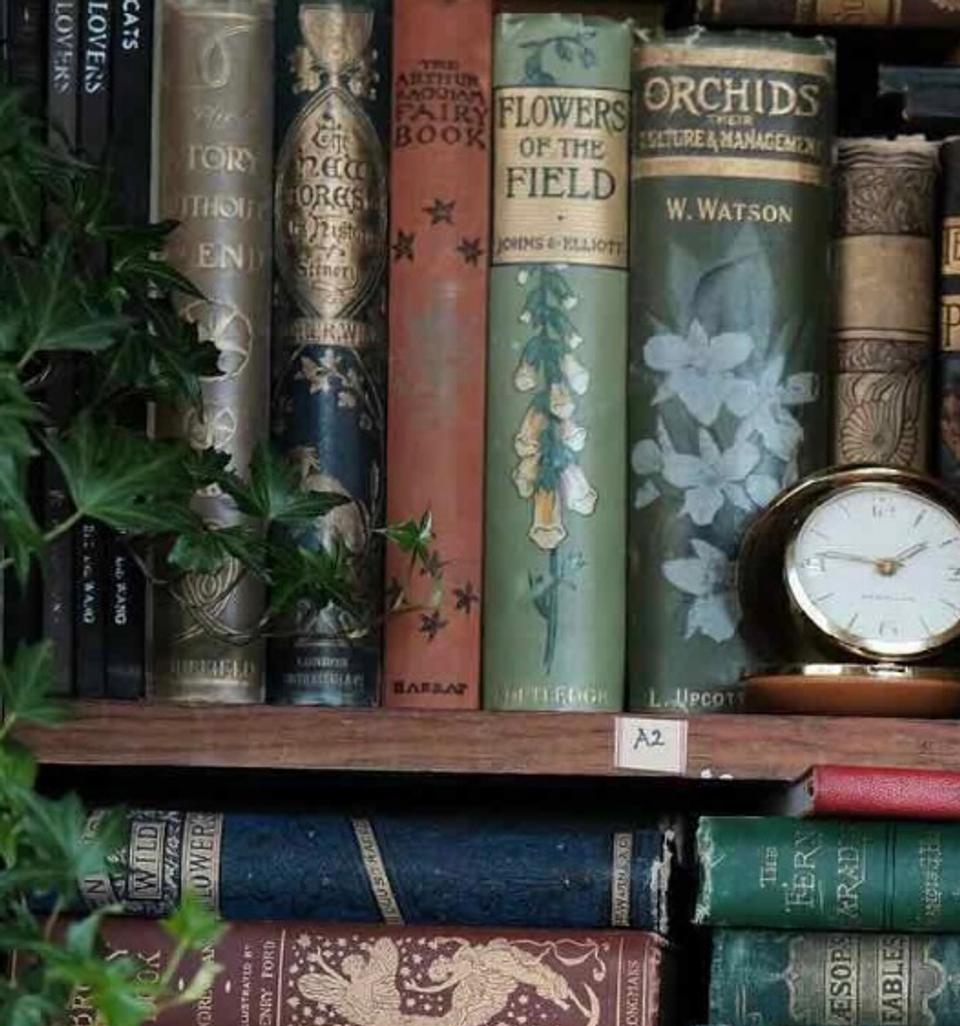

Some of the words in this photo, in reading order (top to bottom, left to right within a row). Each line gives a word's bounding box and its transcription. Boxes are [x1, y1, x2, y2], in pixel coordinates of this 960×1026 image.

[122, 0, 139, 51] CATS
[85, 2, 106, 94] LOVERS
[644, 76, 820, 117] ORCHIDS
[396, 103, 488, 127] FAIRY
[500, 95, 627, 132] FLOWERS
[396, 124, 486, 150] BOOK
[519, 136, 547, 159] OF
[555, 138, 606, 160] THE
[186, 145, 257, 176] TORY
[505, 167, 617, 199] FIELD
[294, 186, 368, 215] ORES
[666, 197, 692, 222] W.
[697, 197, 793, 223] WATSON
[496, 234, 546, 253] JOHNS
[562, 236, 628, 255] ELLIOTT
[634, 728, 666, 750] A2
[134, 825, 161, 895] WILD
[187, 811, 219, 905] LOWER
[259, 939, 275, 985] FORD
[881, 936, 905, 1023] FABLES
